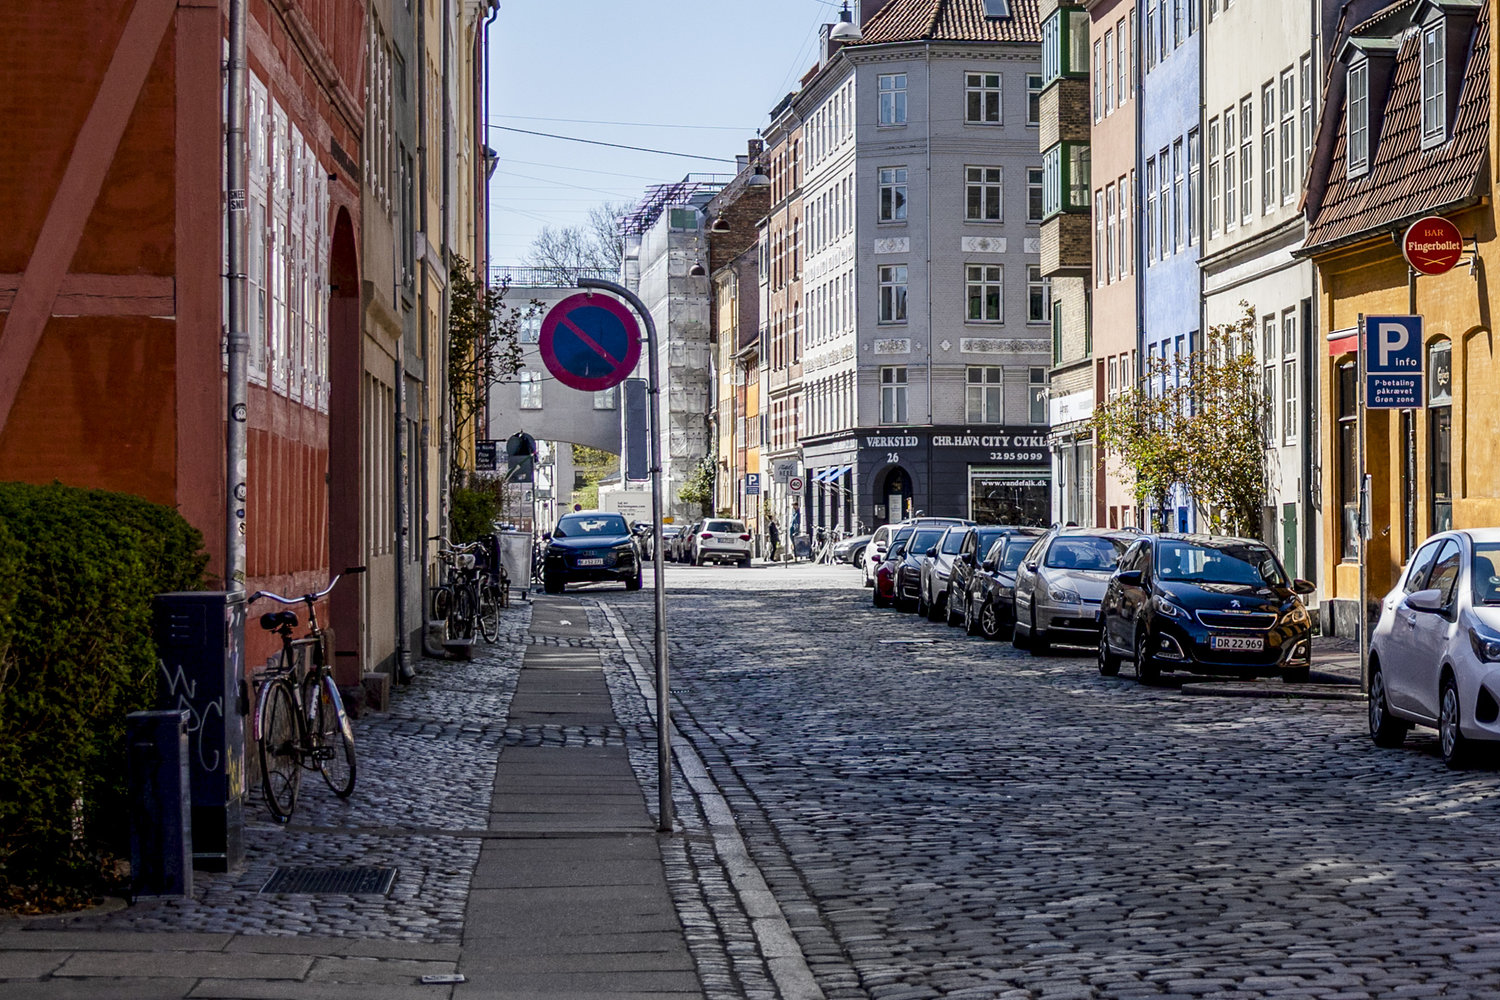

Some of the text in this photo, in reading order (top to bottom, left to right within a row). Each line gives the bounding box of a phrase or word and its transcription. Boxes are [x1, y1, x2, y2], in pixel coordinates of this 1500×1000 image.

[1424, 229, 1444, 237] BAR
[1408, 241, 1460, 253] Fingerbøllet
[1378, 322, 1409, 366] P
[1395, 358, 1417, 366] info
[1374, 379, 1415, 388] P-betaling
[1376, 387, 1413, 396] påkrævet
[866, 436, 918, 447] VÆRKSTED
[932, 436, 1049, 447] CHR.HAVN CITY CYKL
[887, 452, 899, 463] 26
[990, 452, 1002, 460] 32
[1003, 452, 1015, 460] 95
[748, 474, 757, 485] P
[1217, 638, 1263, 649] DR 22 969
